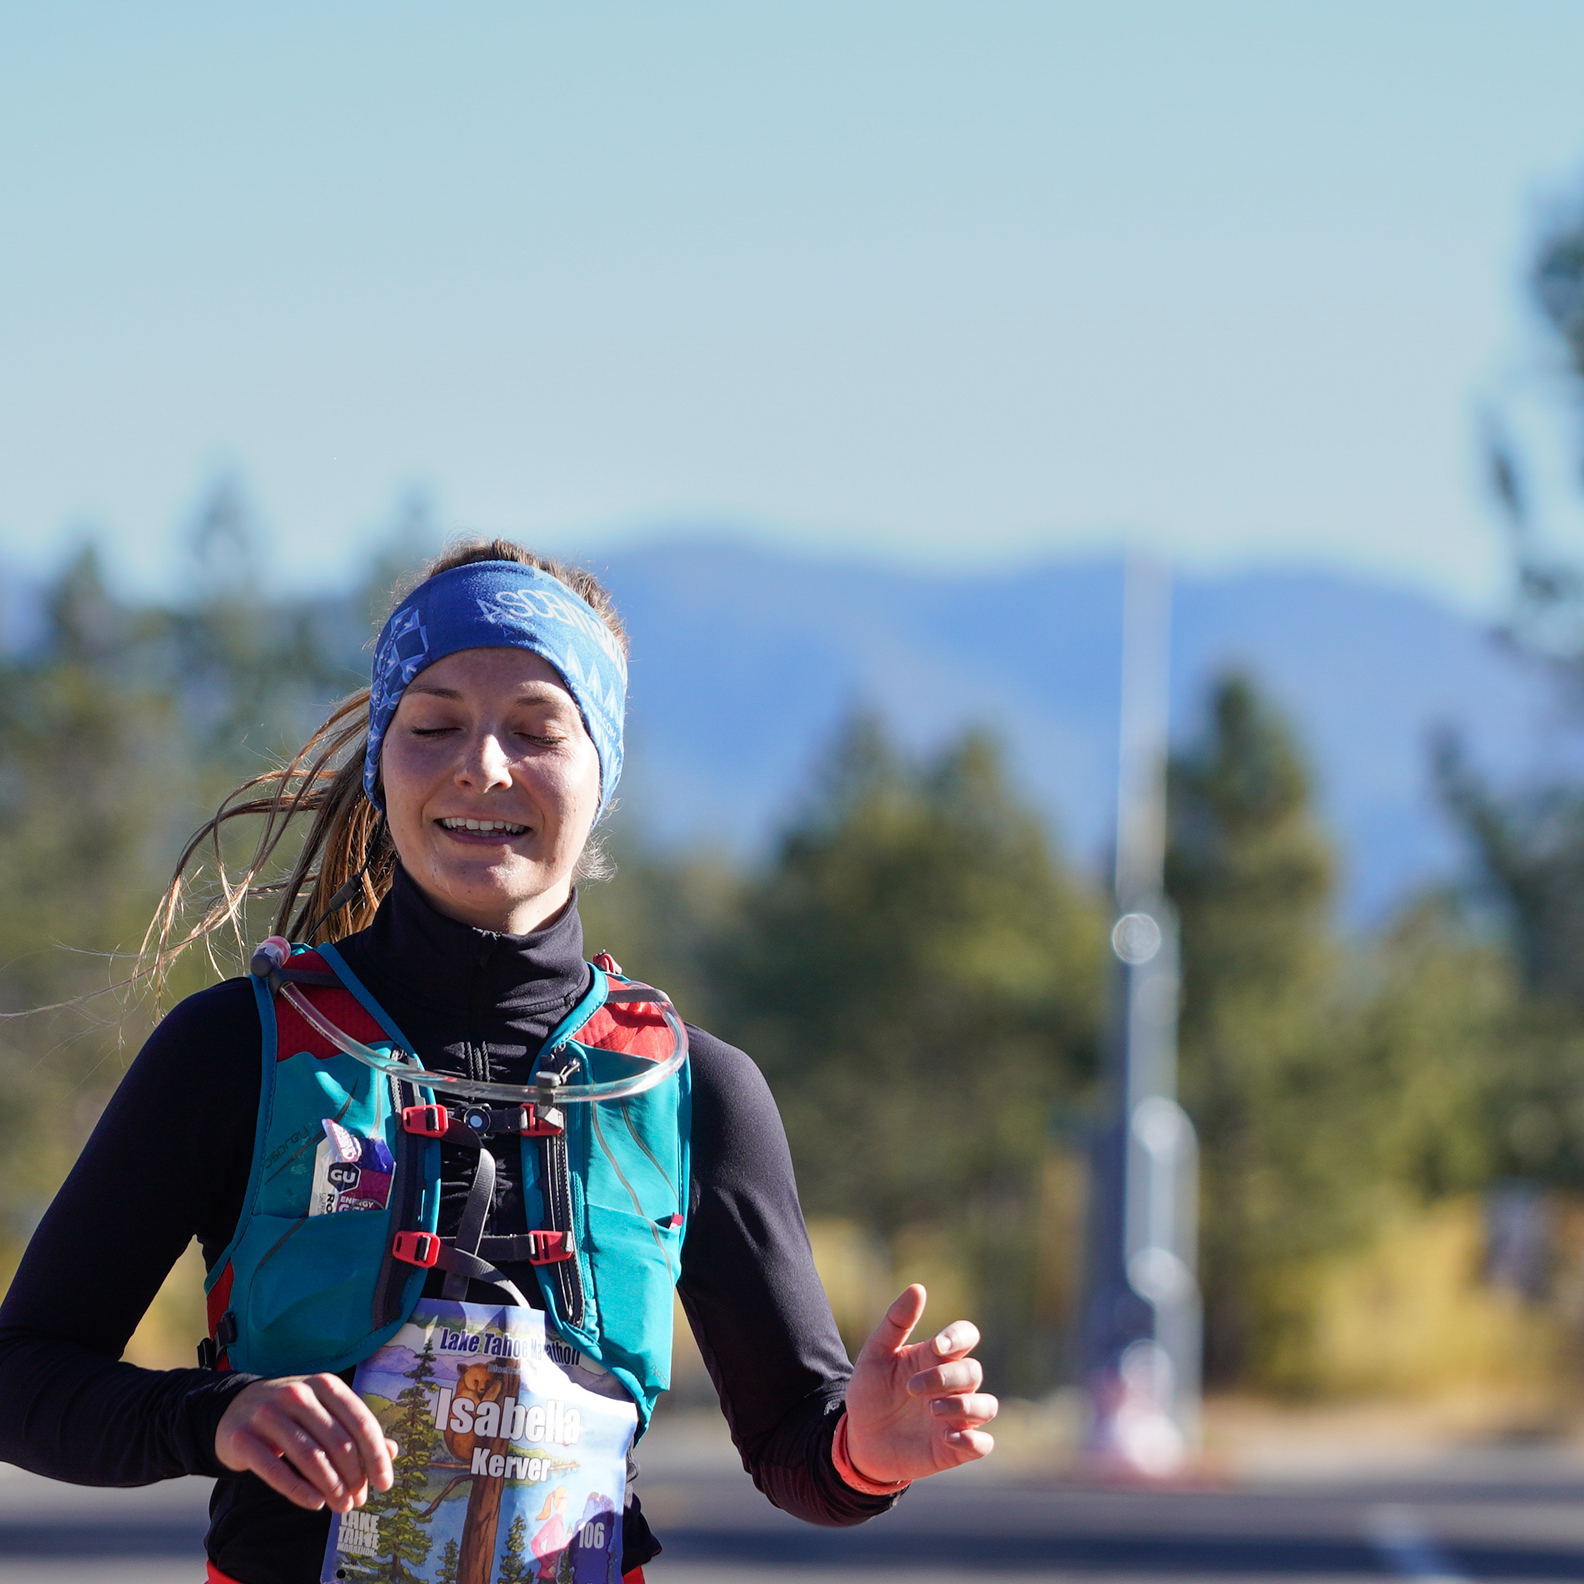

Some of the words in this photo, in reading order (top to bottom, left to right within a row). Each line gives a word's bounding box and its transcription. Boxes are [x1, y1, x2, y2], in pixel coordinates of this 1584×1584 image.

[264, 1125, 310, 1169] osprey
[330, 1168, 356, 1184] GU
[440, 1328, 480, 1352] Lake
[483, 1332, 528, 1359] Tahoe
[530, 1338, 580, 1366] Marathon
[434, 1387, 581, 1445] Isabella
[470, 1447, 552, 1482] Kerver
[341, 1510, 380, 1533] LAKE
[578, 1521, 605, 1549] 106
